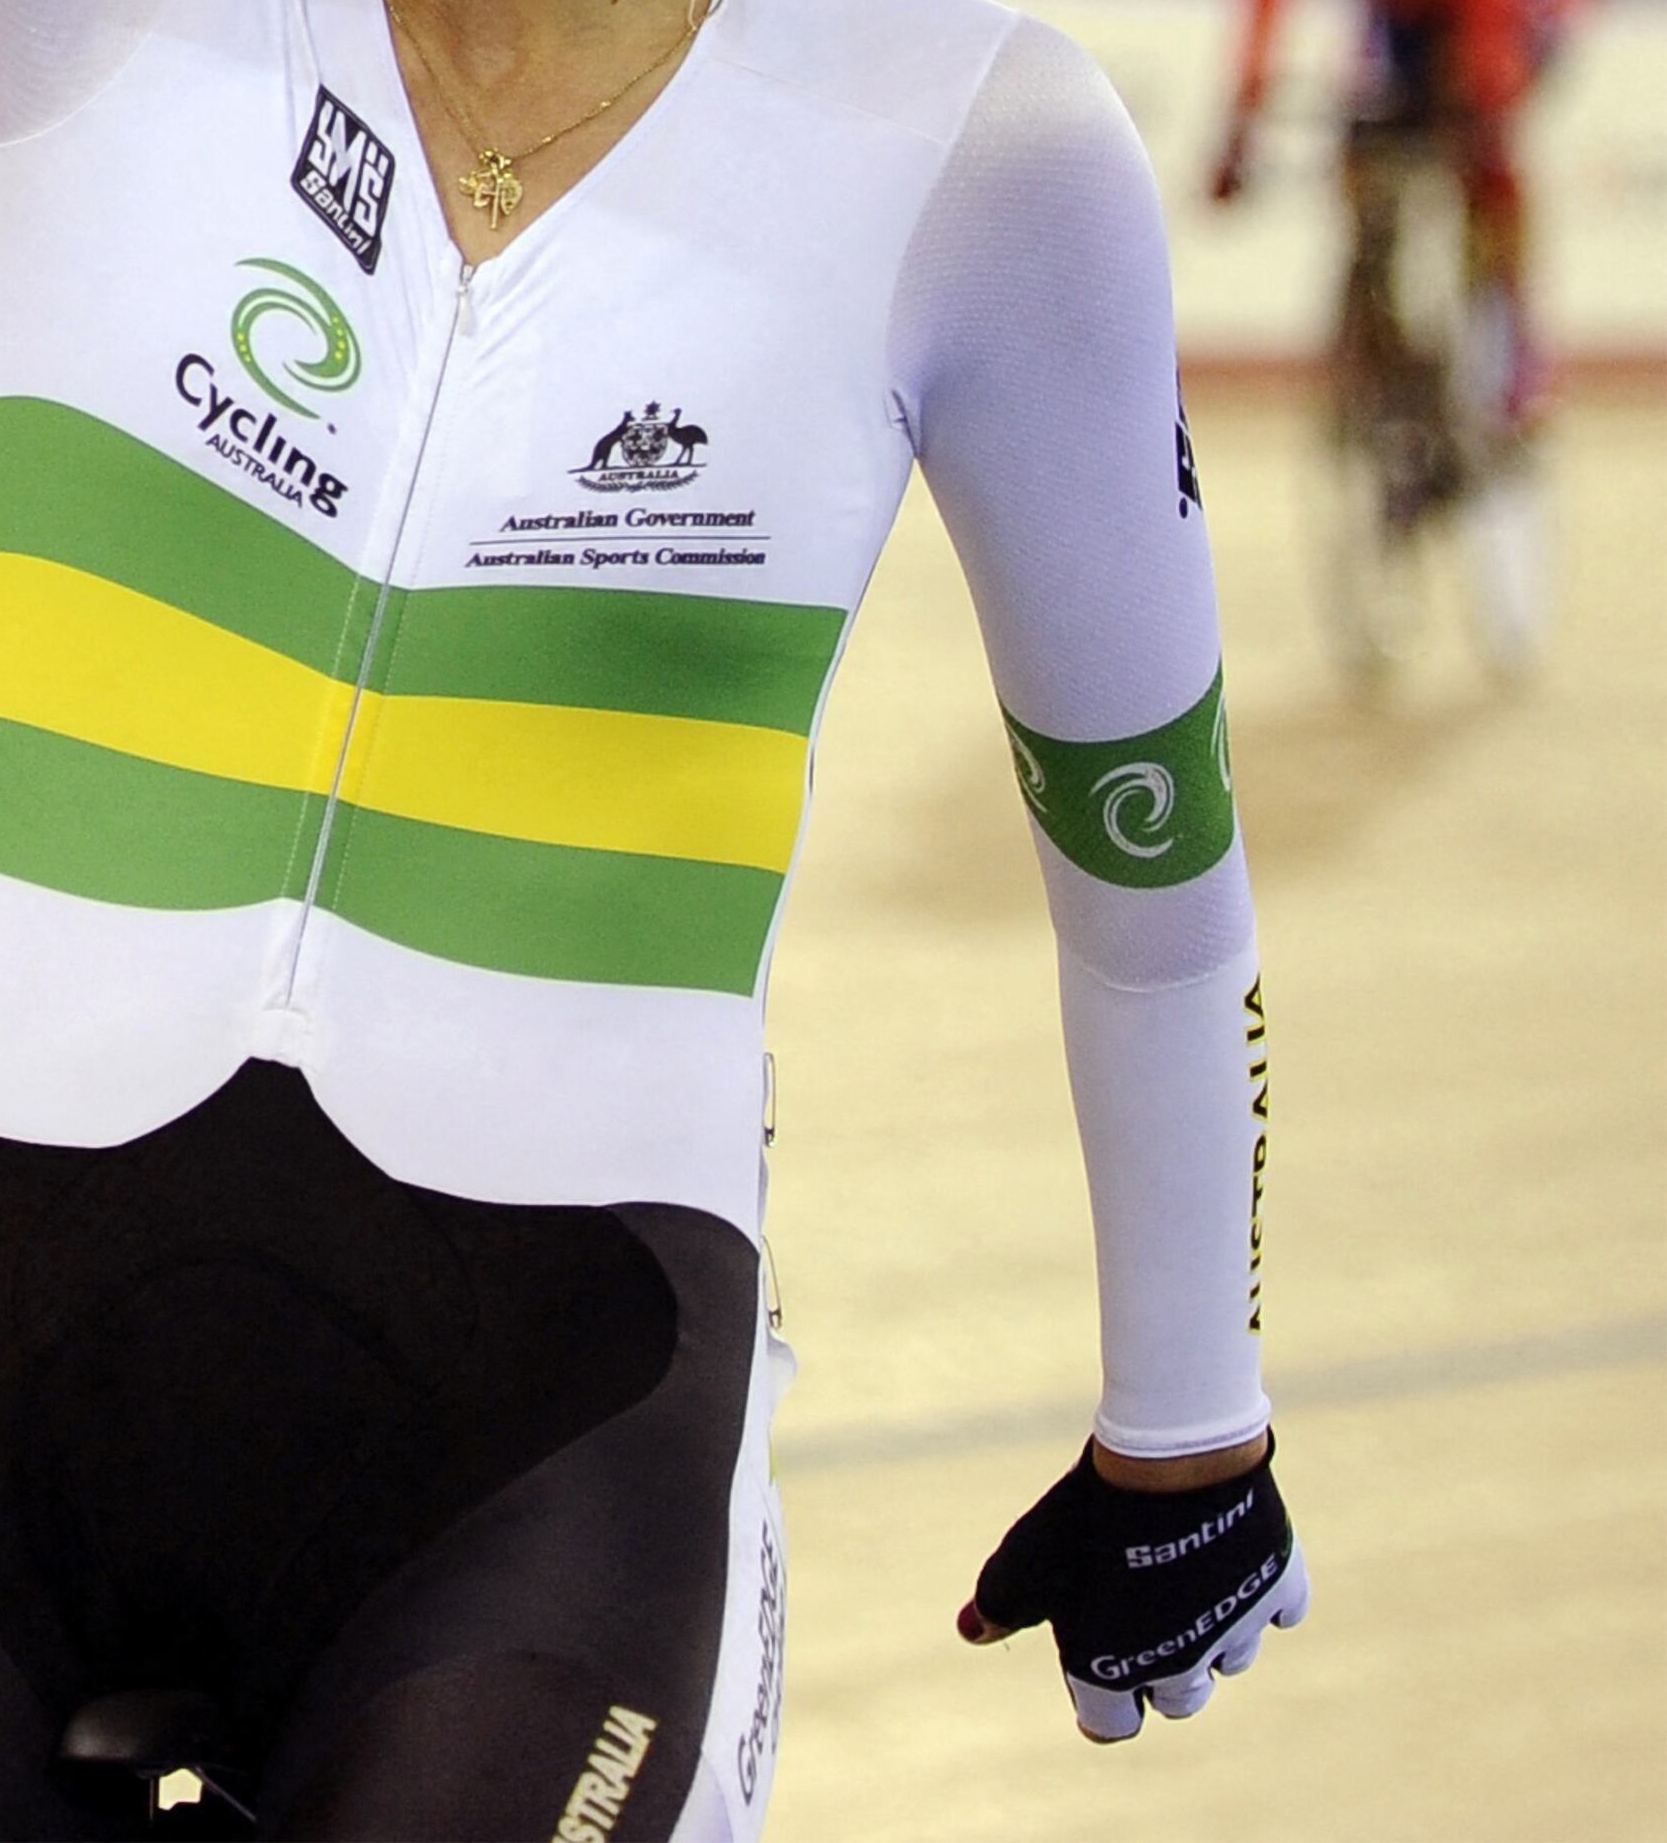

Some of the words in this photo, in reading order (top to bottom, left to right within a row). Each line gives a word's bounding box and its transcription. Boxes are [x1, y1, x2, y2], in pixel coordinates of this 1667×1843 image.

[299, 169, 372, 256] Santini
[175, 353, 349, 519] Cycling
[205, 433, 303, 509] AUSTRALIA
[598, 469, 680, 482] AUSTRALIA
[464, 549, 575, 568] Australian
[579, 548, 650, 570] Sports
[654, 547, 767, 566] Commission
[499, 510, 619, 533] Australian
[624, 508, 757, 528] Government
[1125, 1488, 1256, 1569] Santini
[1090, 1552, 1280, 1681] GreenEDGE
[550, 1705, 659, 1843] STRALIA
